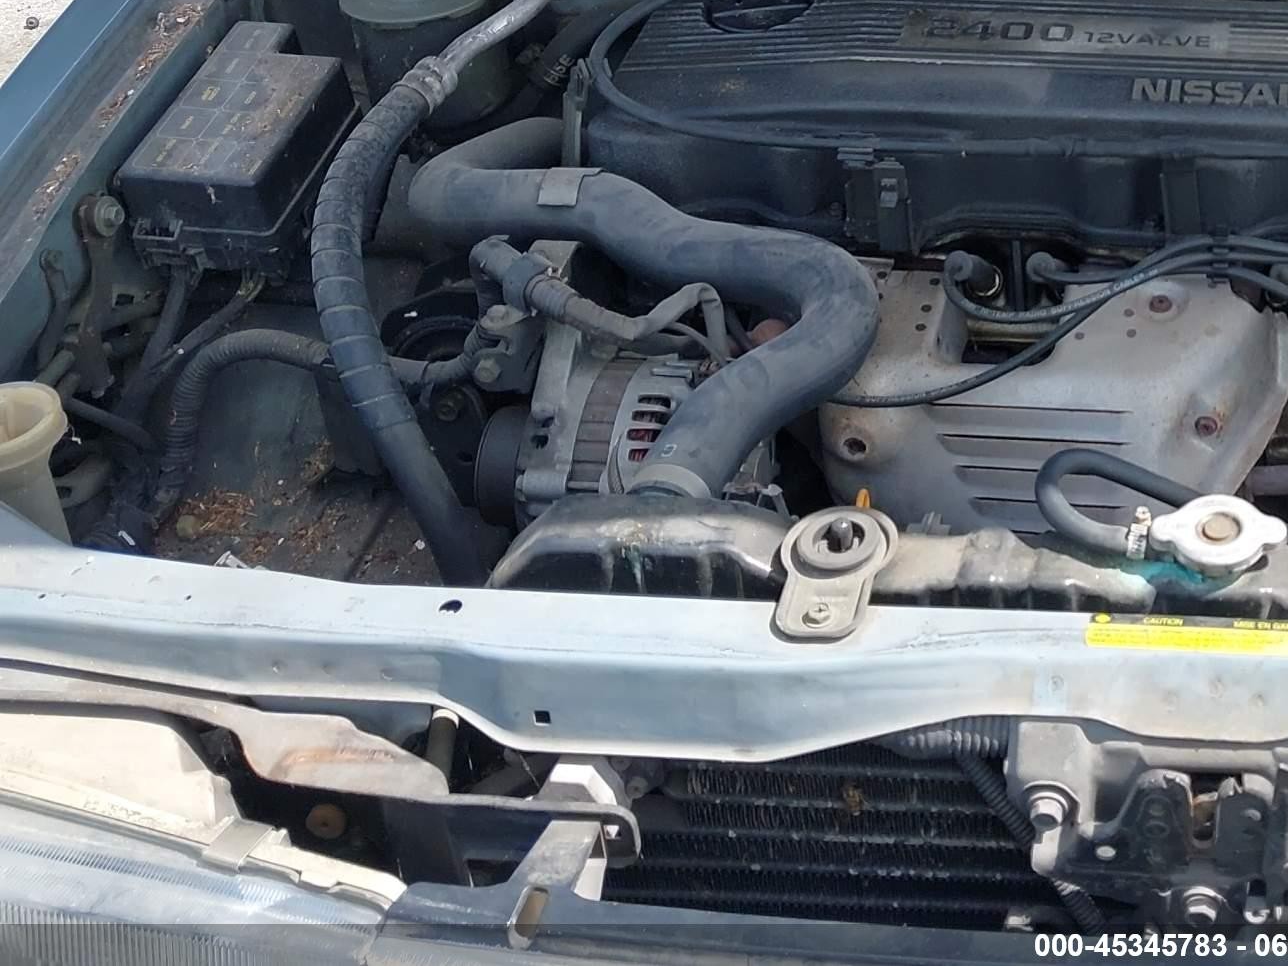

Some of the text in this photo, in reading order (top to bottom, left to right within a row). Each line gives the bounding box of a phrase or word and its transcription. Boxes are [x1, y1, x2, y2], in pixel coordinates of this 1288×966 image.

[925, 17, 1212, 48] 2400 12VALVE
[1143, 616, 1184, 627] CAUTION
[1232, 619, 1256, 629] MISE
[1257, 621, 1271, 630] EN
